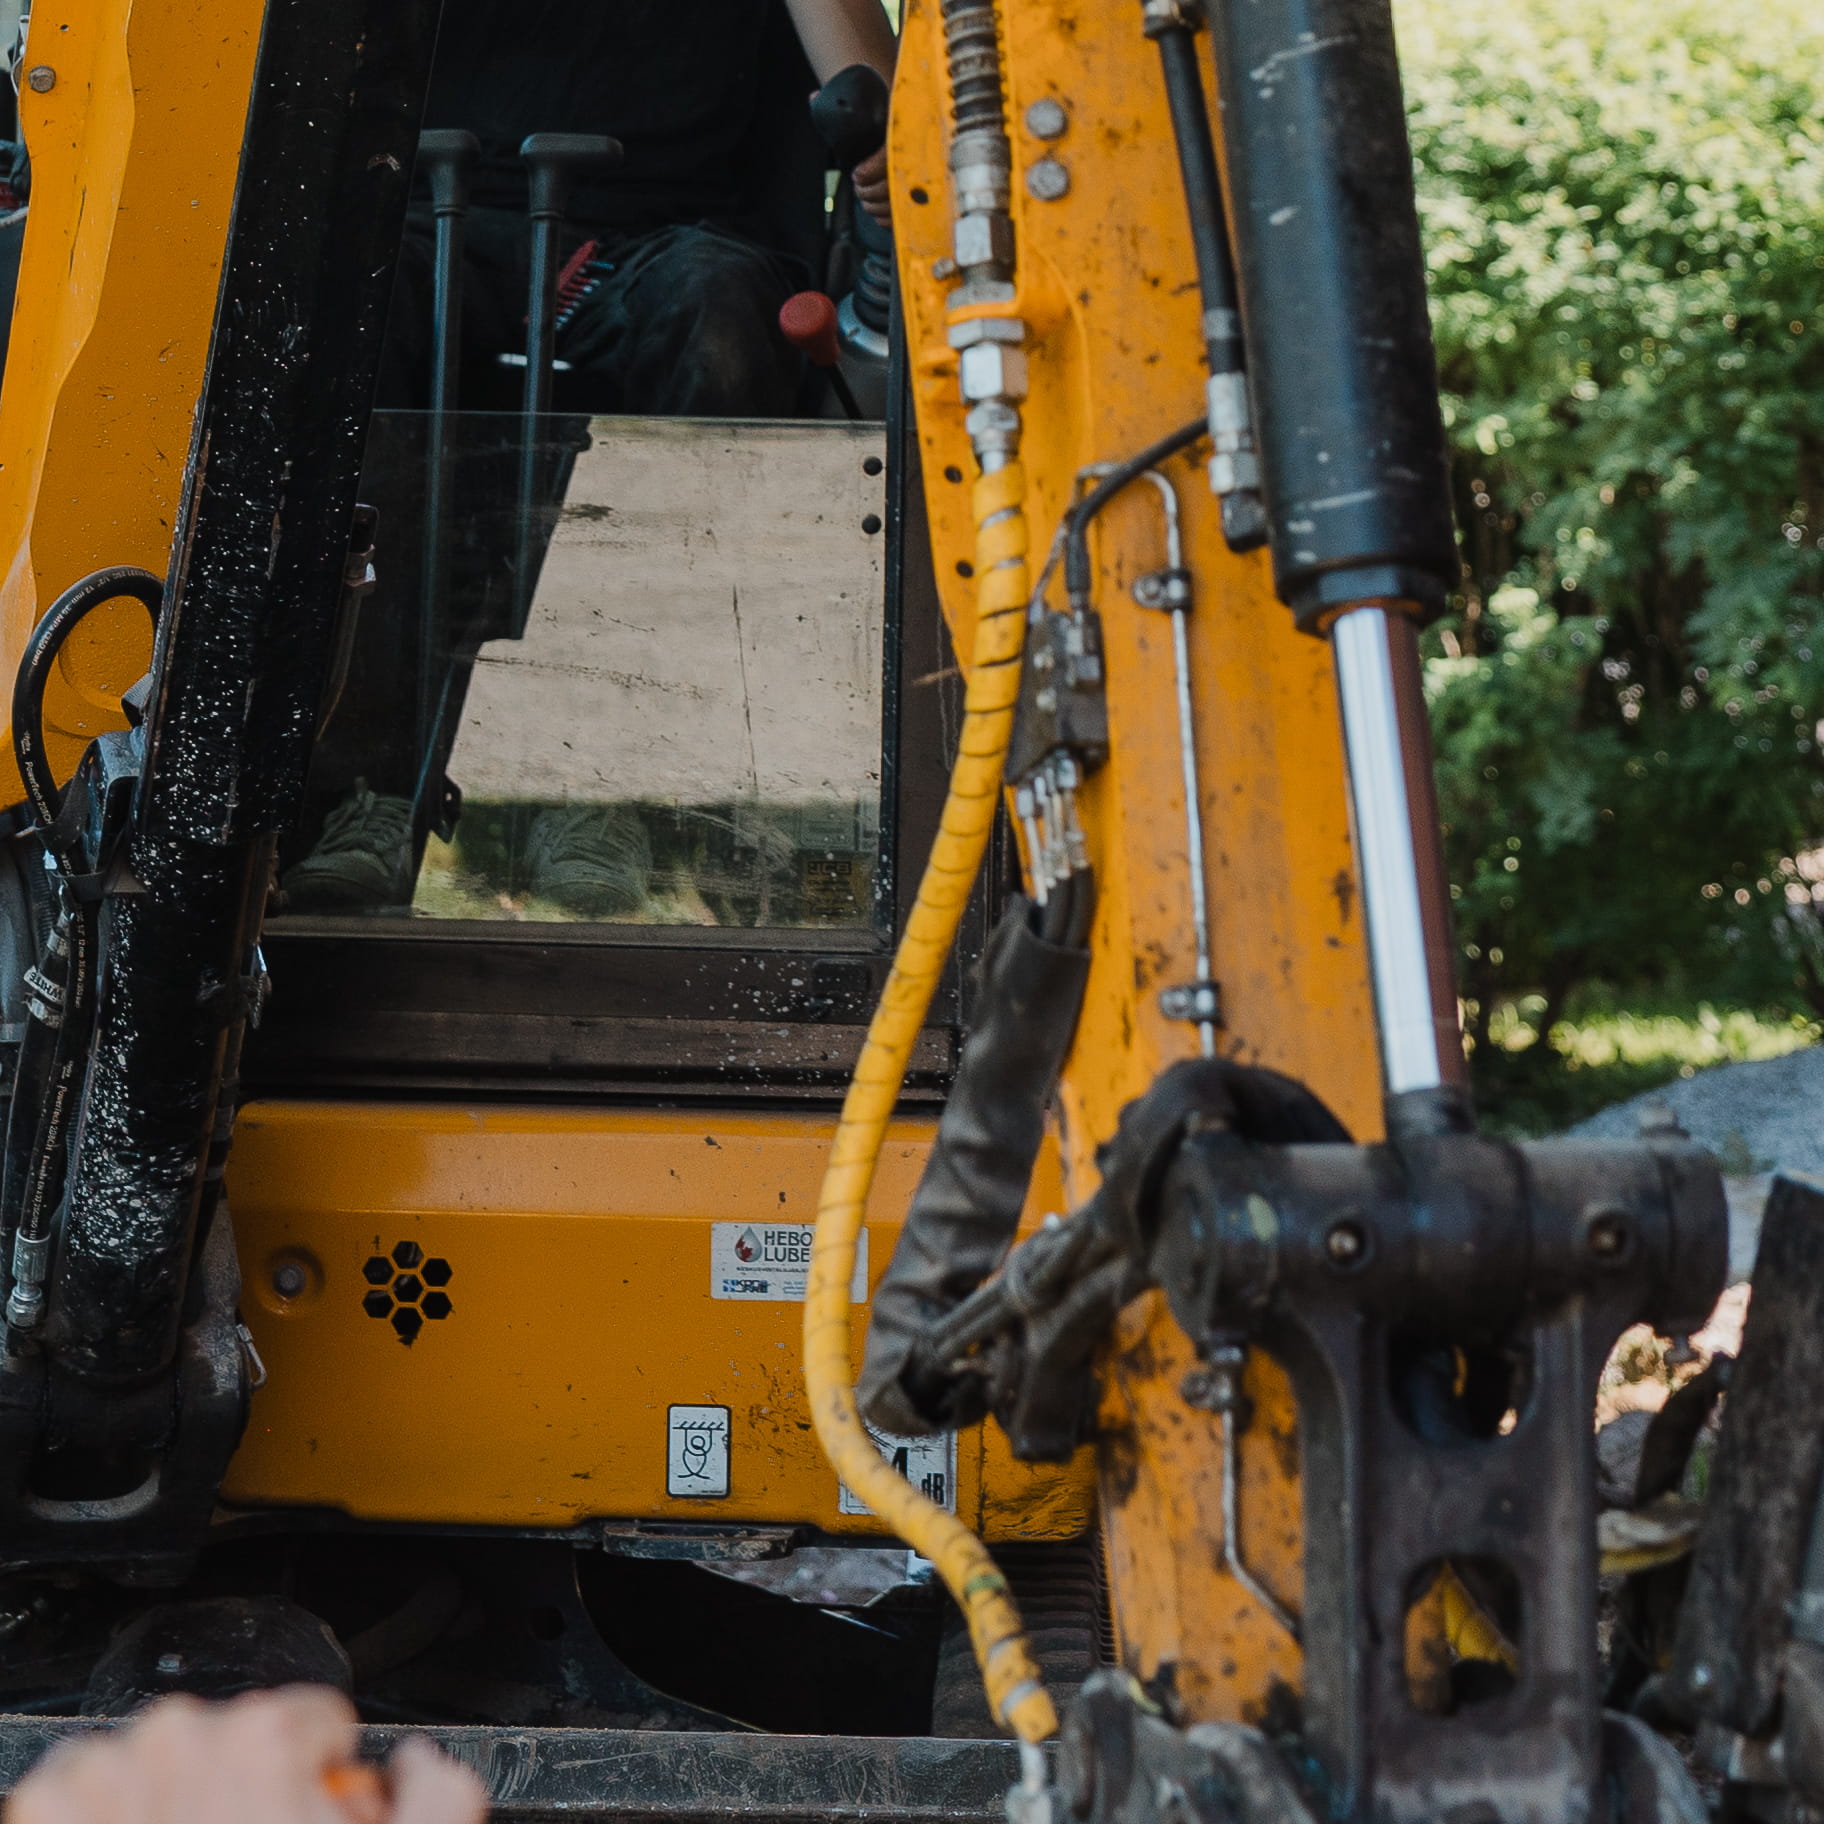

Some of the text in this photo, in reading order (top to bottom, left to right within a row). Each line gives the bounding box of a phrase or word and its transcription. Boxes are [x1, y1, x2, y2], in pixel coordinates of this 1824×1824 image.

[808, 862, 852, 874] JCB
[764, 1230, 813, 1247] HEBO
[764, 1248, 810, 1263] LUBE
[921, 1472, 945, 1506] dB
